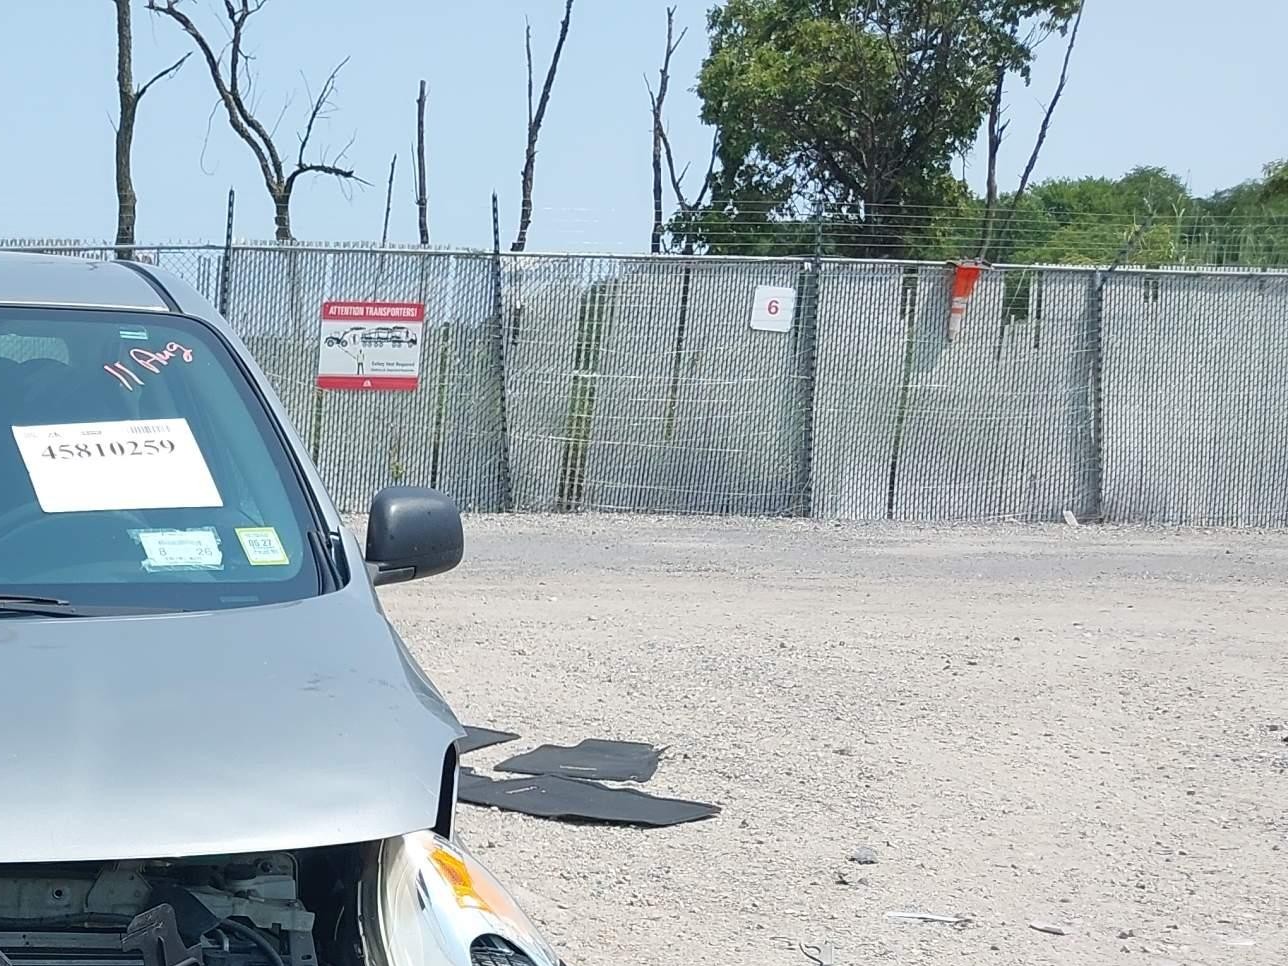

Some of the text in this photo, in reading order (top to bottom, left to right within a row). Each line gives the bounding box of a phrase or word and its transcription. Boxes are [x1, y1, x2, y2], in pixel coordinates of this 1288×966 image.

[328, 306, 418, 317] ATTENTION TRANSPORTERS!
[767, 299, 780, 315] 6
[129, 341, 193, 374] Aug
[31, 438, 176, 461] 45810259
